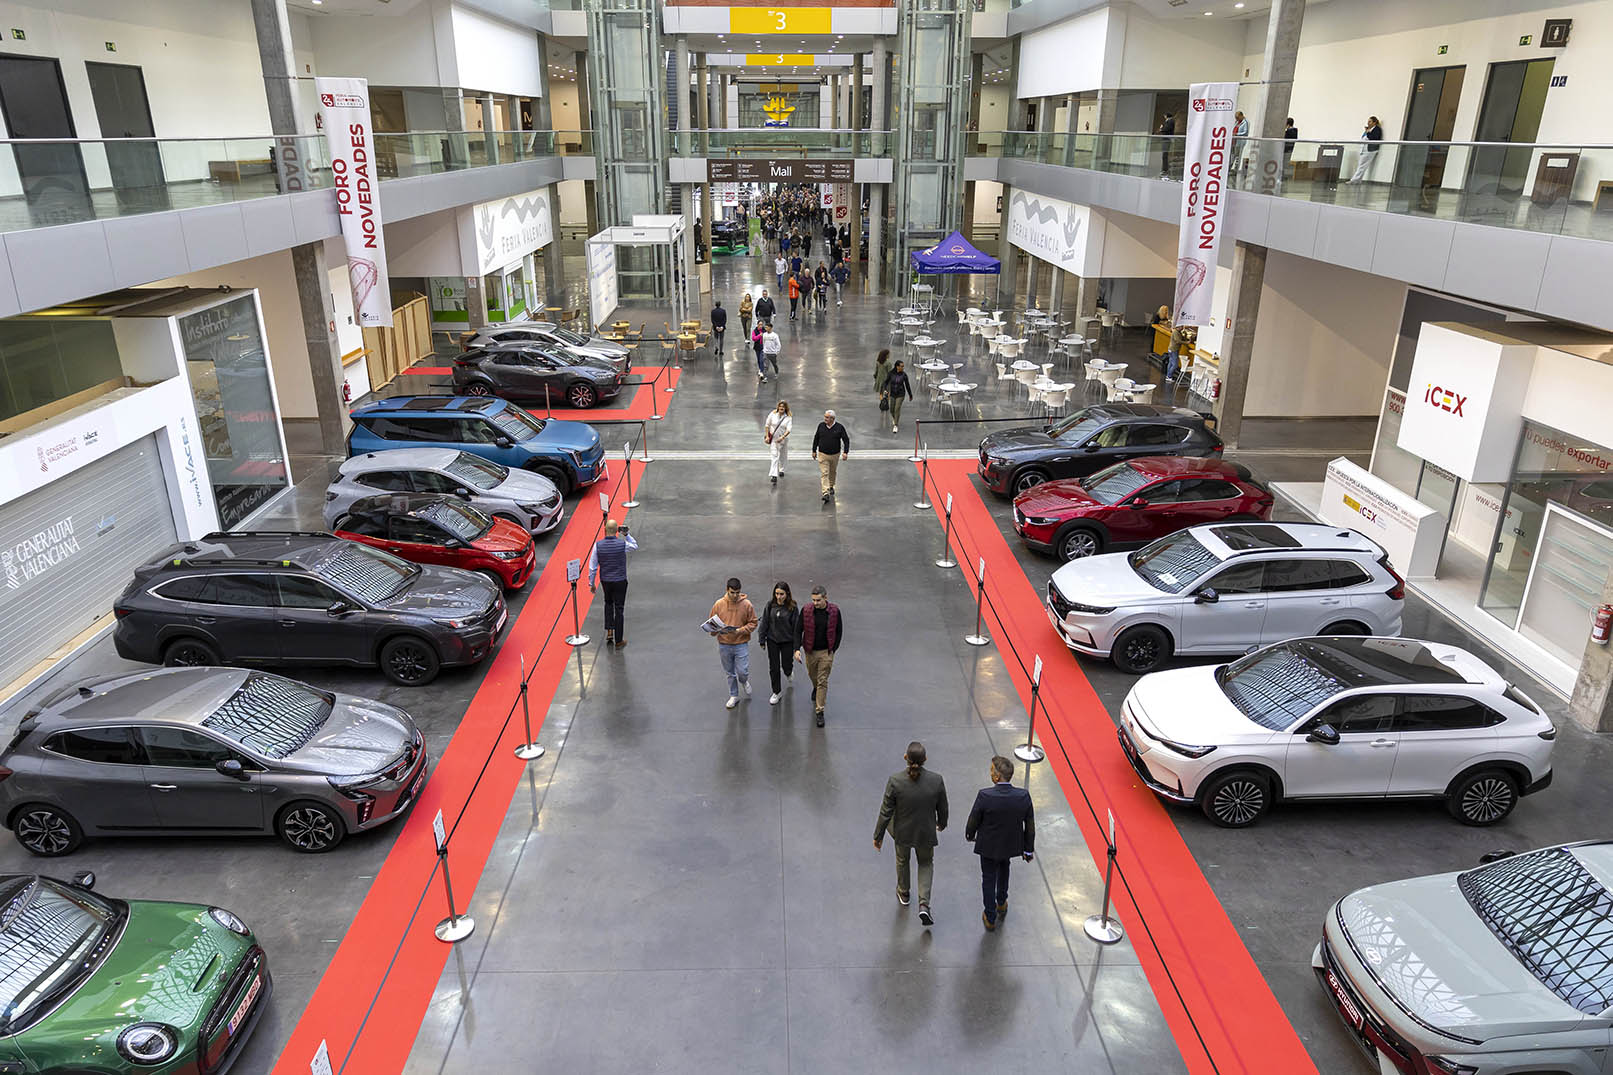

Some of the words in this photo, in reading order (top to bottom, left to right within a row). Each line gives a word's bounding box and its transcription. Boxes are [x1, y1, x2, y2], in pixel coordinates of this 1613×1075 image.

[776, 12, 786, 30] 3
[776, 53, 784, 64] 3
[332, 158, 353, 215] FORO
[349, 123, 377, 249] NOVEDADES
[770, 165, 792, 177] Mall
[1198, 126, 1227, 249] NOVEDADES
[1187, 162, 1202, 217] FORO
[501, 231, 522, 255] FERIA
[521, 222, 547, 246] VALENCIA
[1012, 218, 1028, 241] FERIA
[1029, 226, 1060, 254] VALENCIA
[184, 309, 229, 343] Instituto
[45, 436, 77, 457] GENERALITAT
[47, 446, 79, 463] VALENCIANA
[1533, 434, 1566, 453] puedes
[1568, 447, 1611, 470] exportar
[16, 515, 74, 562] GENERALITAT
[20, 535, 81, 581] VALENCIANA
[1337, 987, 1359, 1021] HYUNDAI
